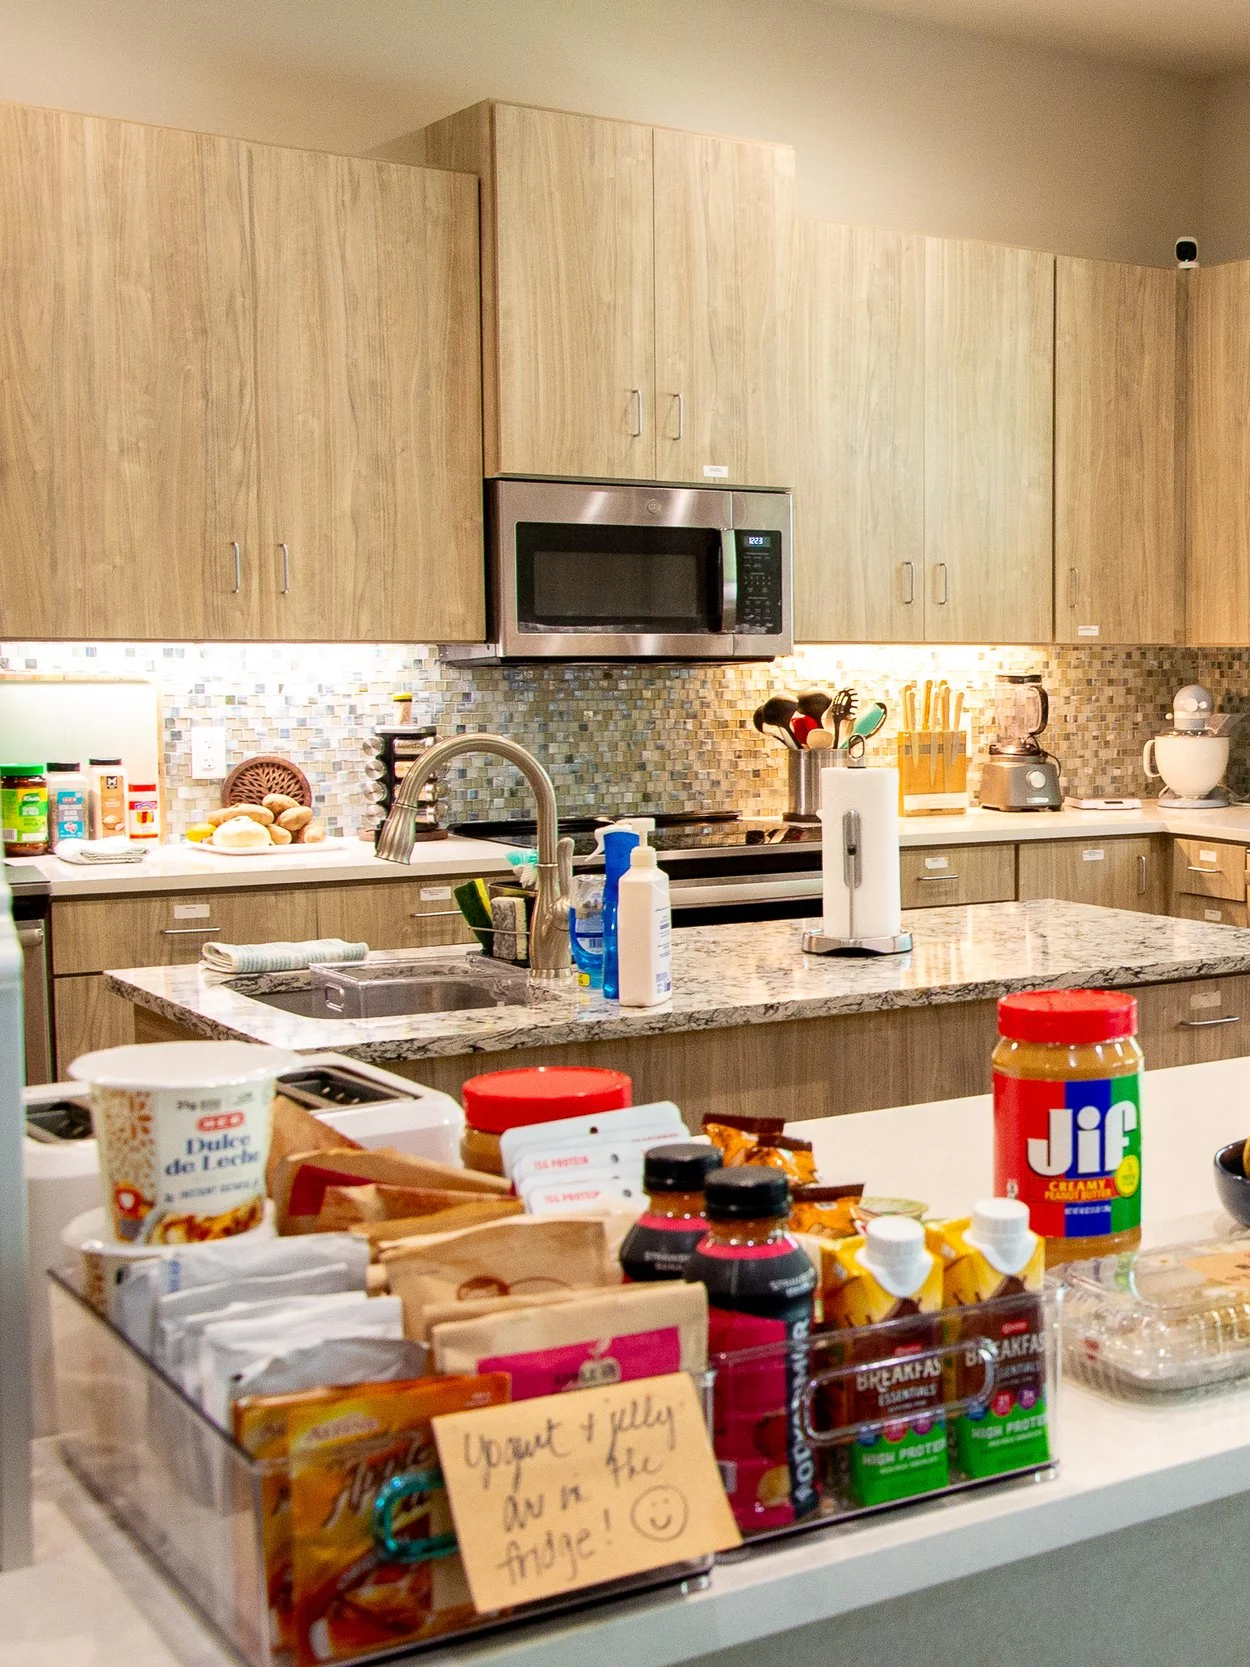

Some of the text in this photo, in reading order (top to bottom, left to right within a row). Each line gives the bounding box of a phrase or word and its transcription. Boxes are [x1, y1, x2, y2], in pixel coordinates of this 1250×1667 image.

[186, 1133, 250, 1155] Dulce
[1027, 1100, 1138, 1177] Jif
[165, 1149, 259, 1176] de Leche
[550, 1155, 590, 1169] PROTEIN
[1044, 1188, 1113, 1201] PEANUT BUTTER
[1048, 1179, 1107, 1192] CREAMY
[856, 1358, 942, 1393] BREAKFAS
[878, 1382, 938, 1408] ESSENTIALS
[606, 1395, 678, 1465] jelly
[971, 1426, 1003, 1440] HIGH
[605, 1447, 664, 1489] the
[862, 1451, 897, 1466] HIGH
